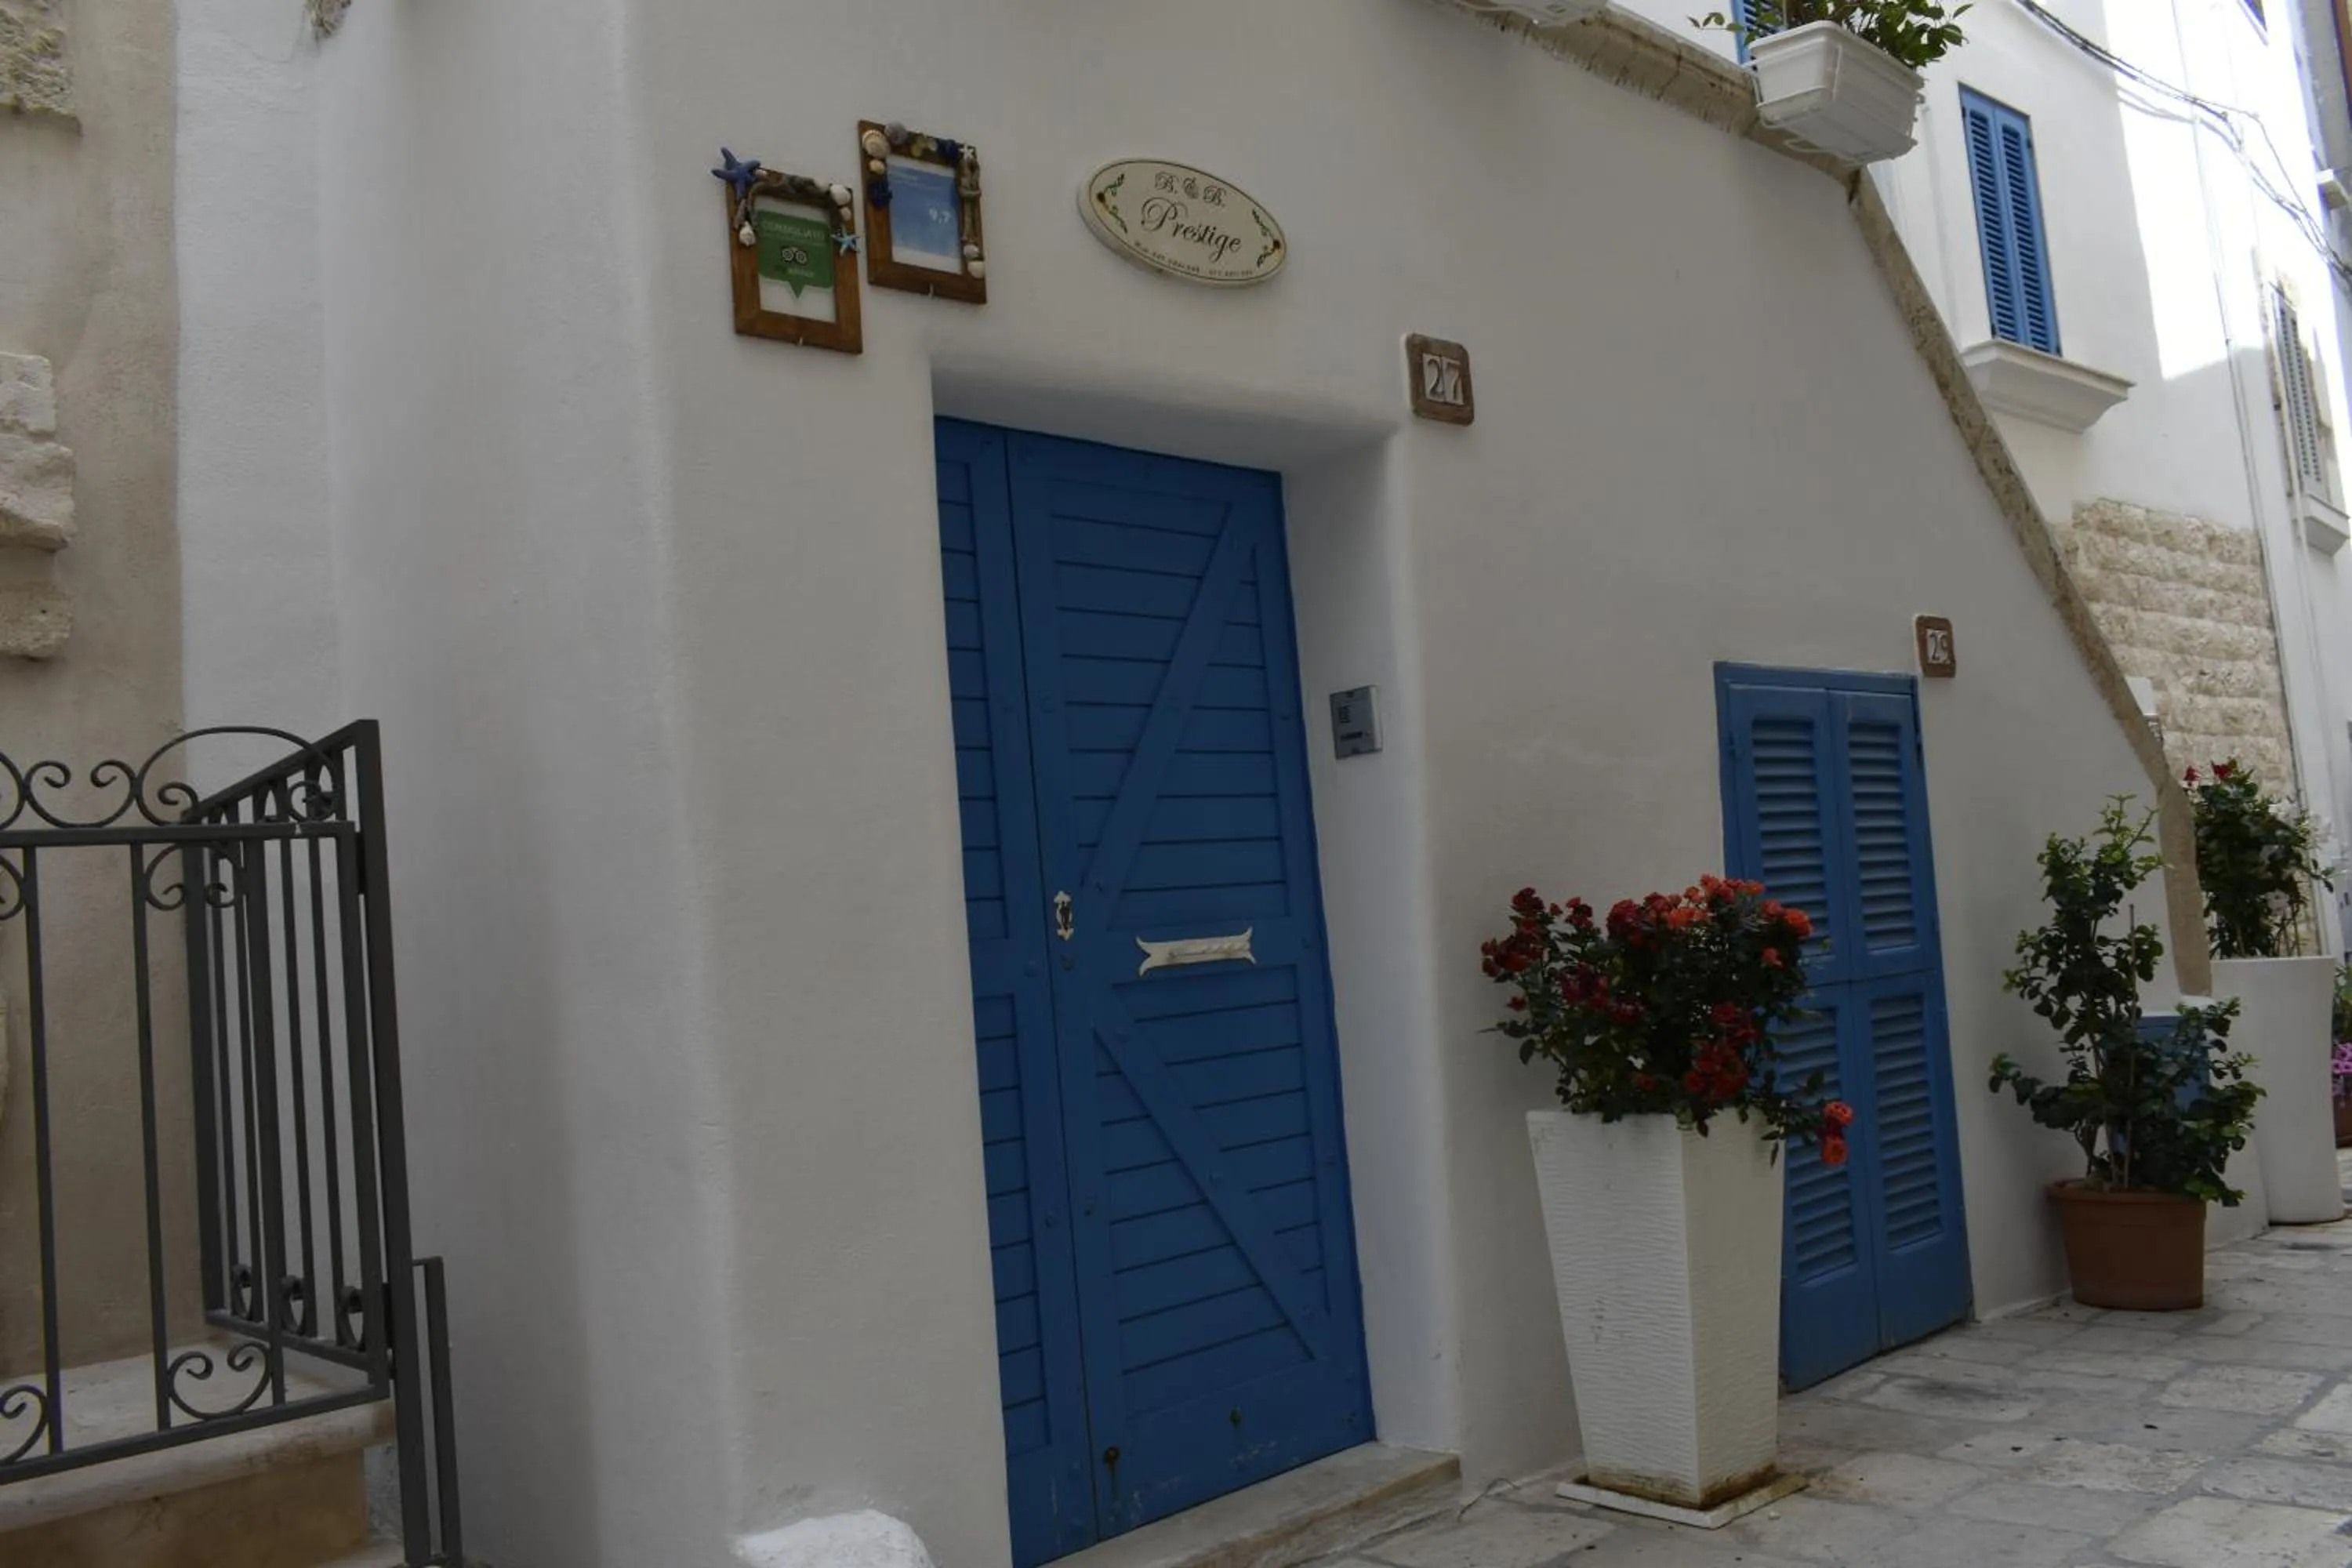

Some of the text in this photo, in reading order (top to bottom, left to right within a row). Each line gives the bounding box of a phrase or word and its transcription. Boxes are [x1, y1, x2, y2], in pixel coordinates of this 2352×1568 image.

[1181, 176, 1199, 199] &
[1140, 196, 1243, 262] Prestige
[1427, 358, 1463, 401] 27
